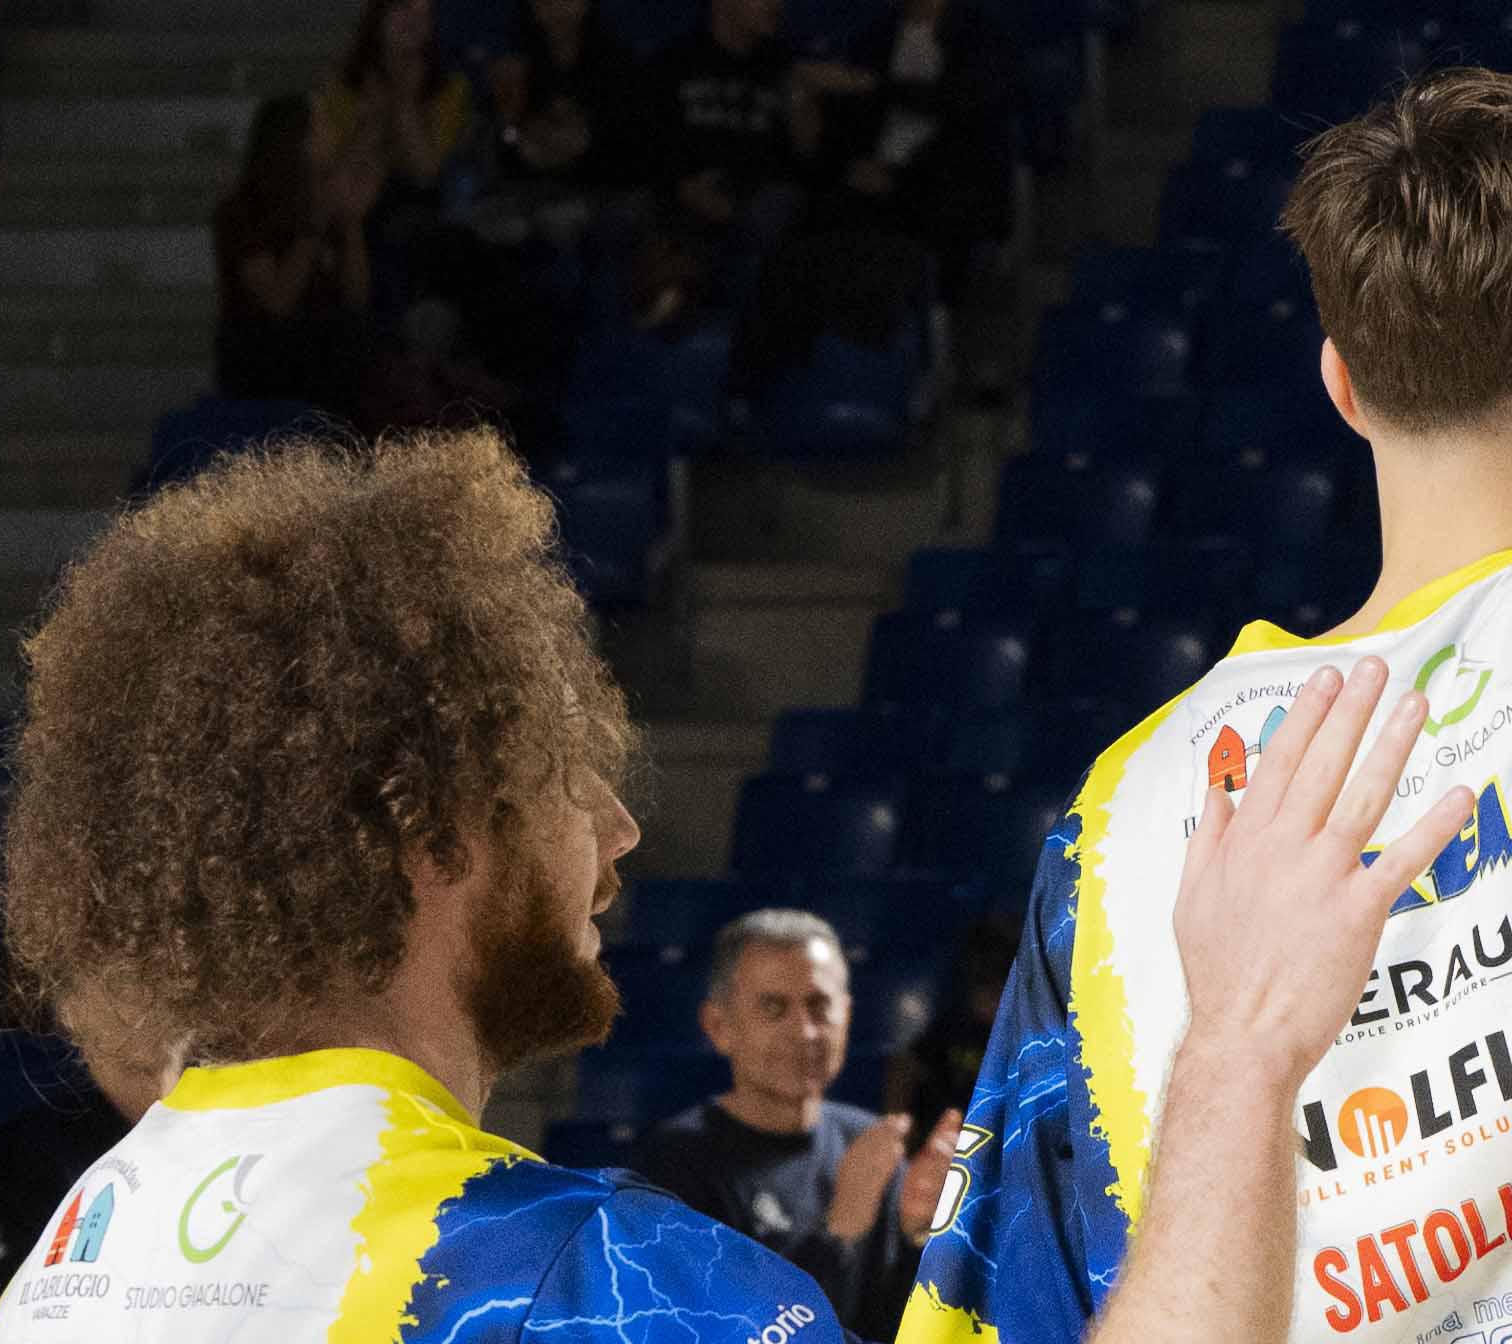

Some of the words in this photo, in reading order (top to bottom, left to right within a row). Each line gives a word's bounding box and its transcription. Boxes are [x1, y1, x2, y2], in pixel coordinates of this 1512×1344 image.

[1190, 702, 1232, 746] rooms
[1248, 681, 1306, 700] breakf
[1334, 1025, 1387, 1046] EOPLE
[1395, 1008, 1439, 1031] DRIVE
[1445, 977, 1488, 1011] FUTURE
[1297, 1182, 1347, 1209] ULL
[1365, 1150, 1430, 1185] RENT
[124, 1285, 177, 1310] STUDIO
[176, 1283, 271, 1307] GIACALONE
